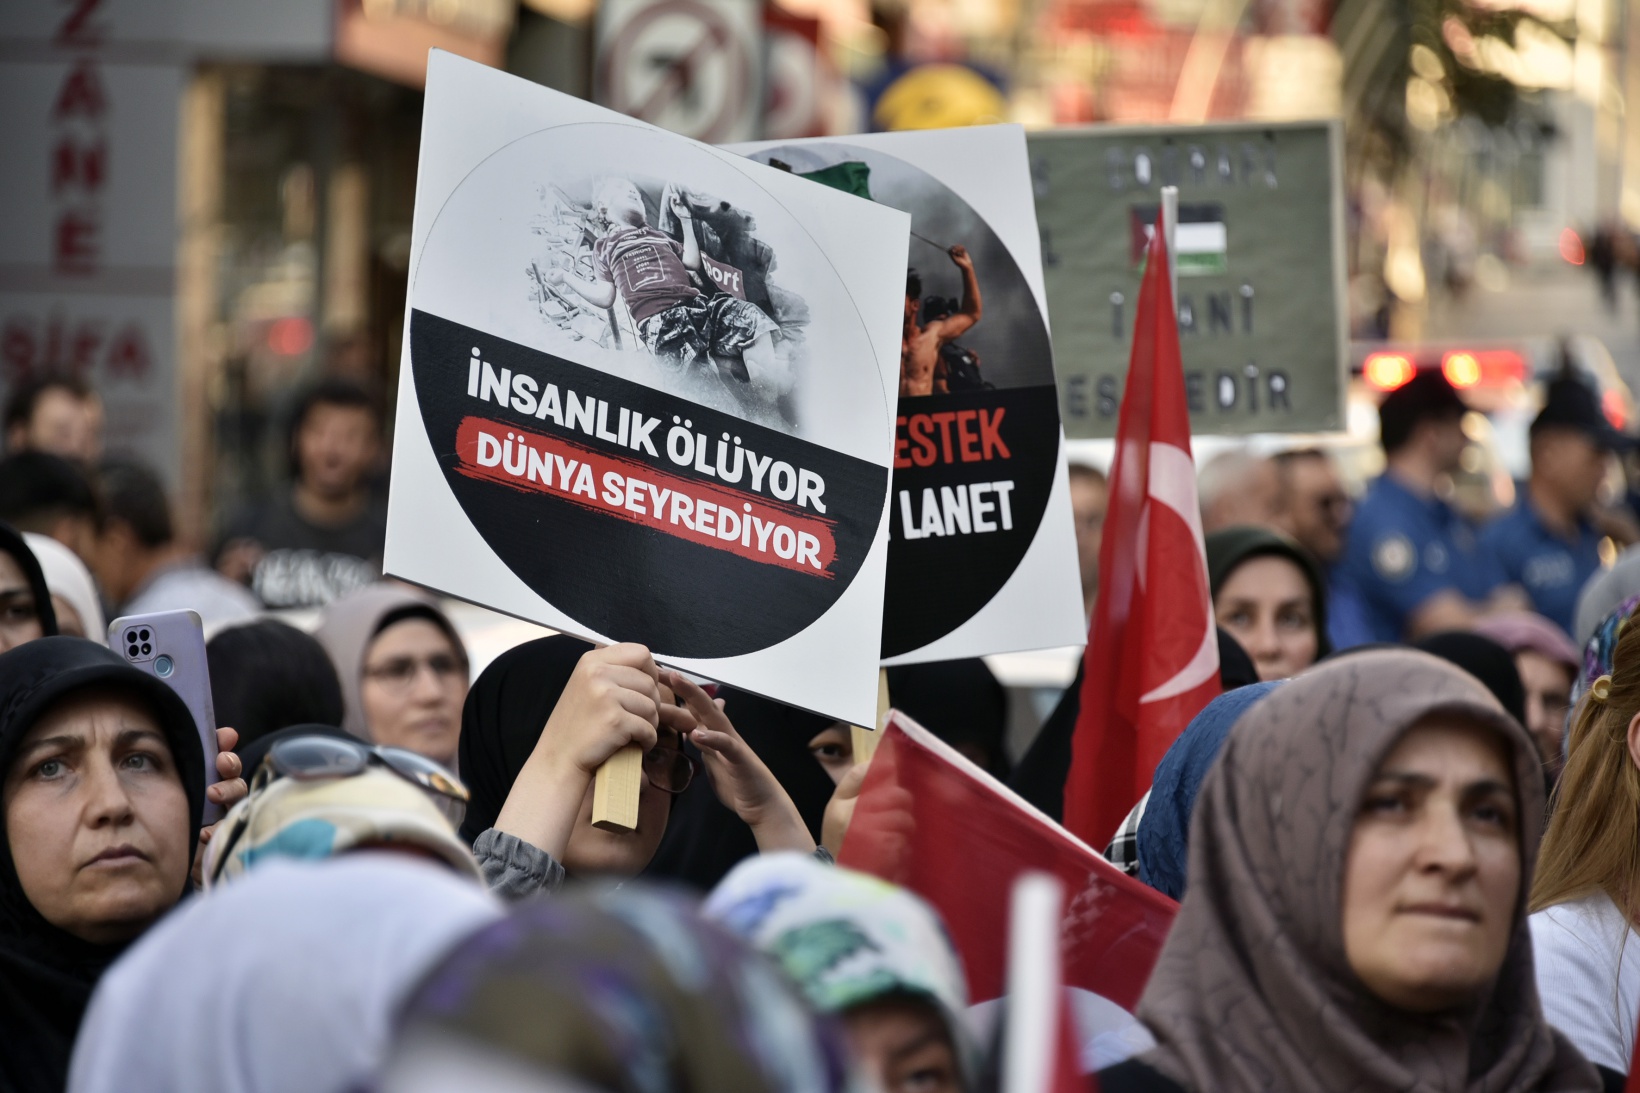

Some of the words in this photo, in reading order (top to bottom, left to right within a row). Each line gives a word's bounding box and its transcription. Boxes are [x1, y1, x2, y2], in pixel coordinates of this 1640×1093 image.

[1109, 284, 1254, 338] İANİ
[467, 347, 662, 458] İNSANLIK
[666, 415, 827, 513] ÖLÜYOR
[476, 430, 597, 500] DÜNYA
[601, 476, 822, 570] SEYREDİYOR
[899, 480, 1015, 540] LANET
